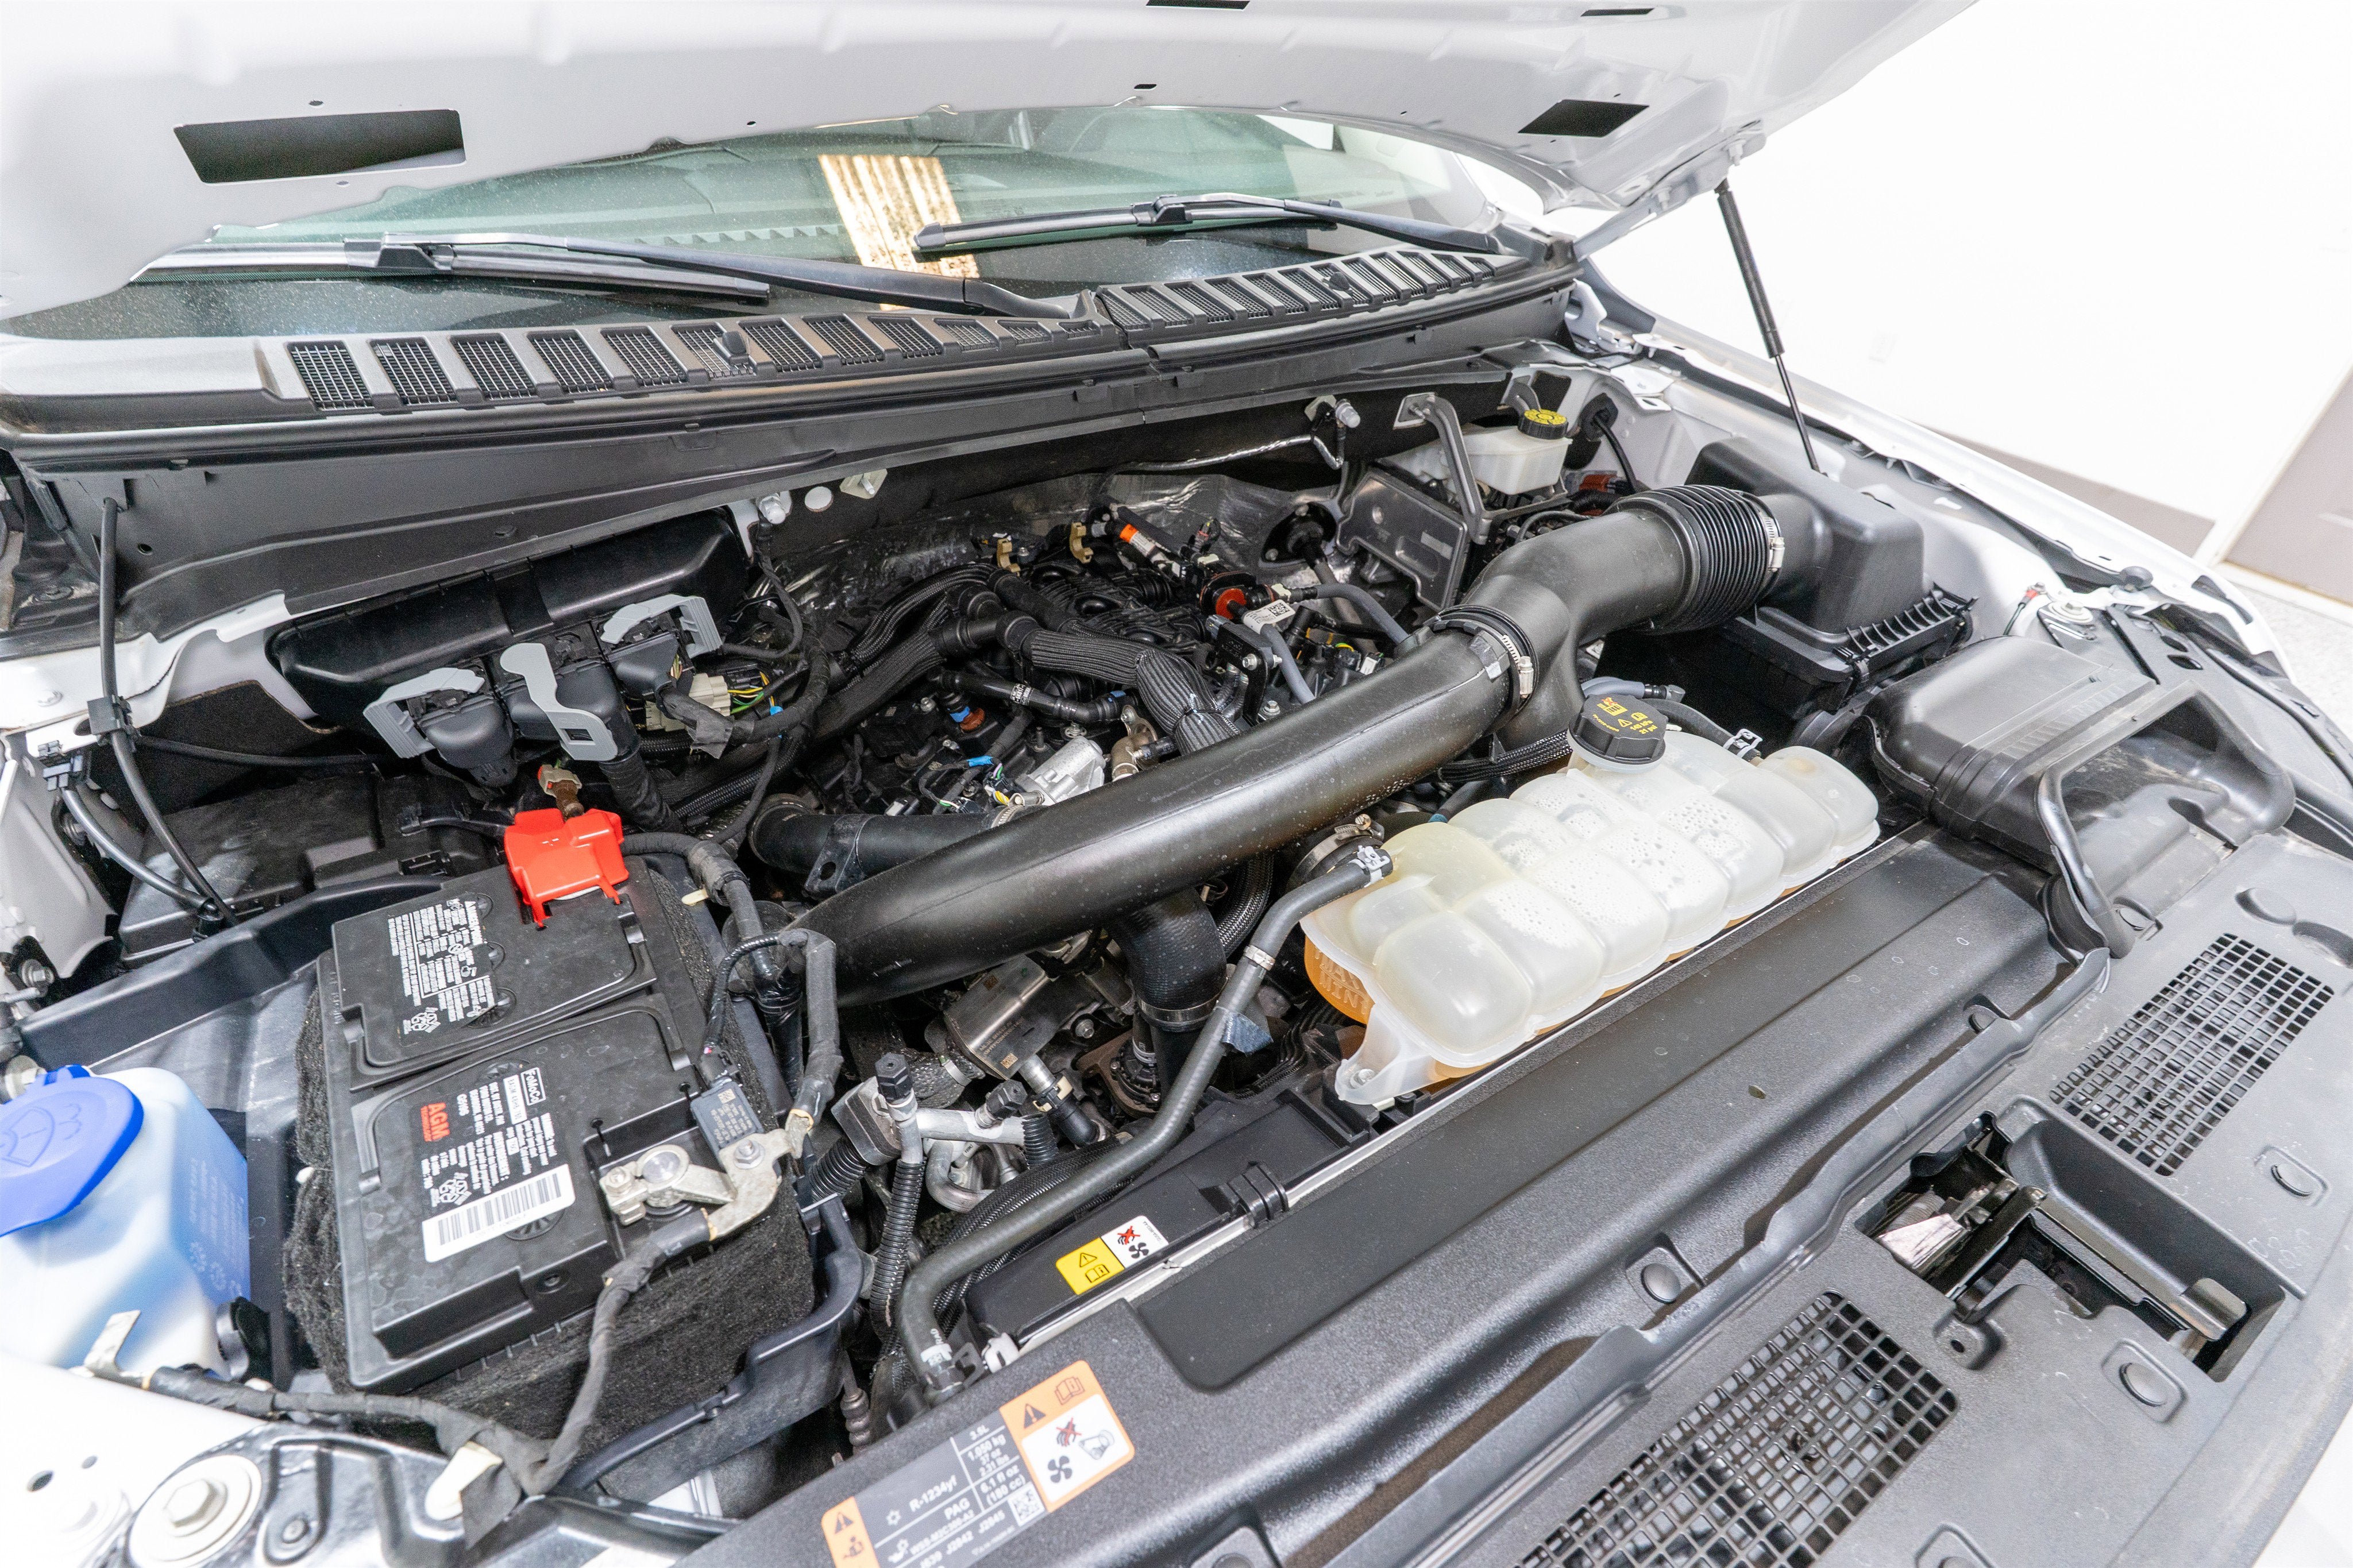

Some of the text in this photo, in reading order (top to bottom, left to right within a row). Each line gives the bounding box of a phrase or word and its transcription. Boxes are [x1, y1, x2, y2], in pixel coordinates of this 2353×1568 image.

[1319, 971, 1359, 1009] MIN
[524, 1069, 541, 1103] FoMoCo
[428, 1101, 450, 1141] AGM
[967, 1432, 1006, 1461] 1.050 kg
[979, 1453, 992, 1465] 37
[908, 1475, 959, 1512] R-1234yf
[979, 1477, 997, 1493] 6.1
[1004, 1465, 1020, 1478] oz
[1008, 1473, 1026, 1491] cc)
[944, 1497, 970, 1520] PAG
